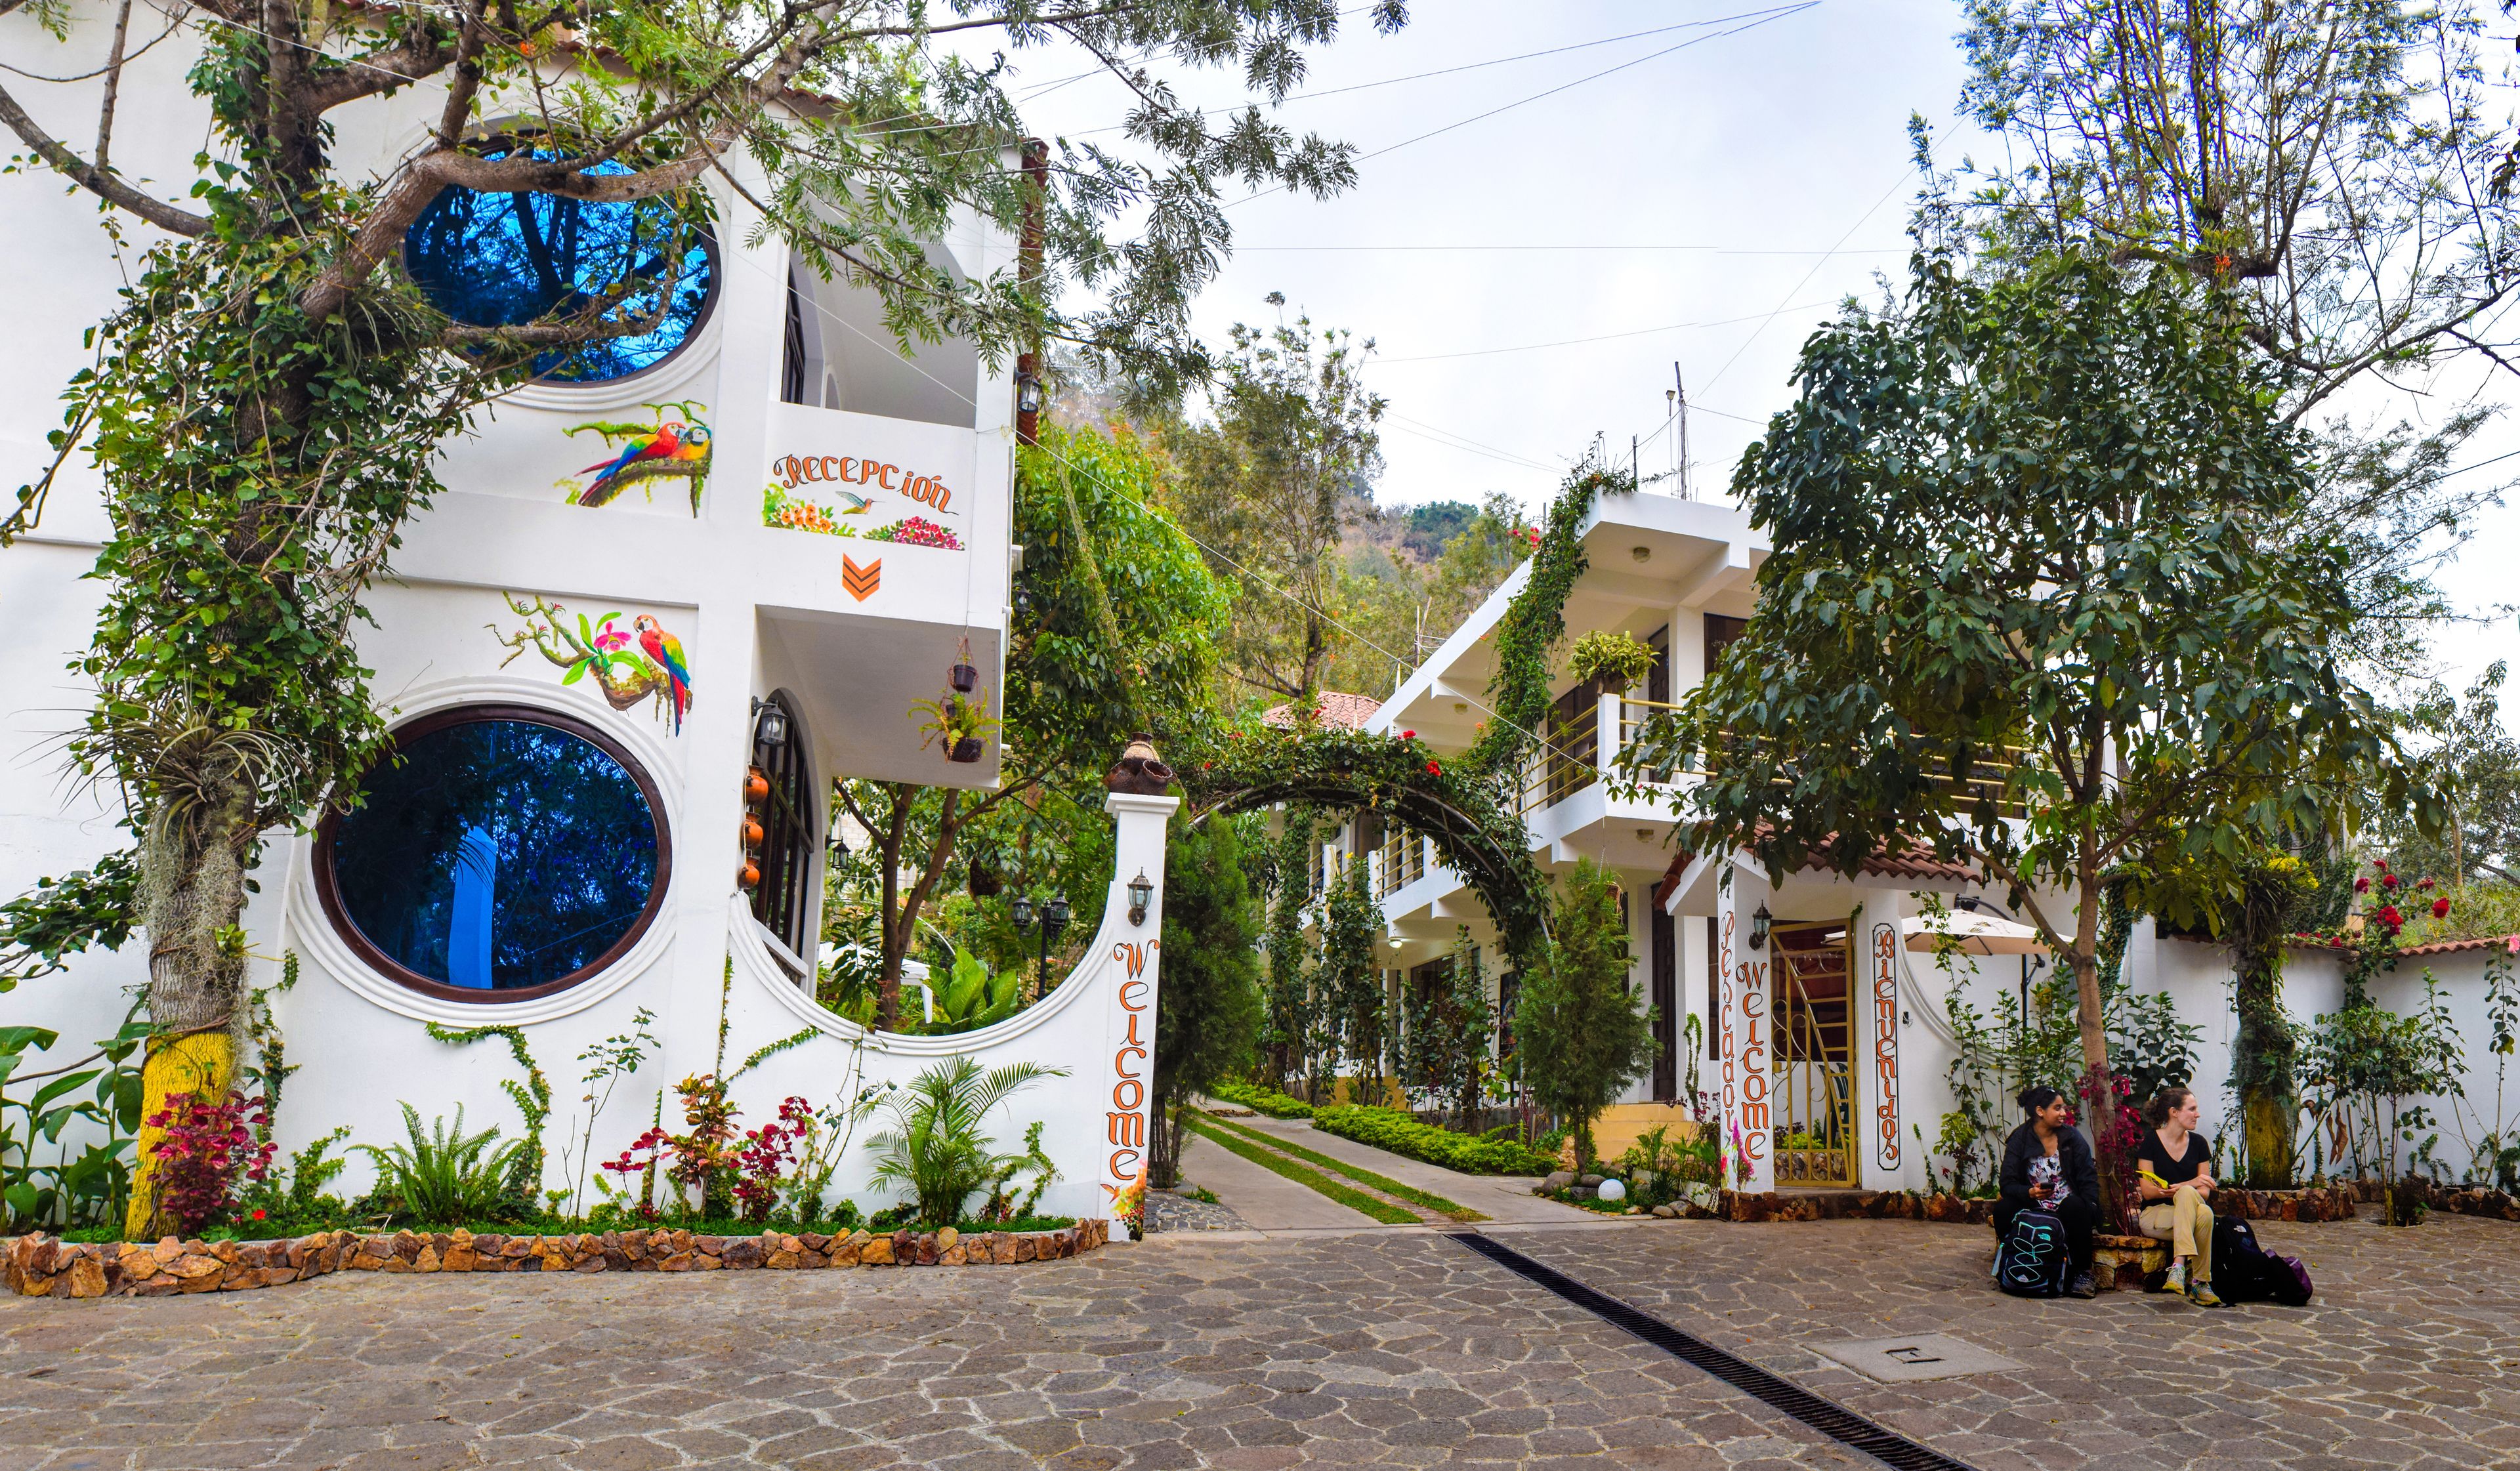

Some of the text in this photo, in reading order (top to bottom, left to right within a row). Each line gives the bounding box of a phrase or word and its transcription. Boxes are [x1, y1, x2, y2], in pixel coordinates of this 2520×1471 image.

[1106, 939, 1160, 1181] Welcome
[1736, 961, 1771, 1161] Welcome
[1875, 929, 1898, 1160] Bienvenidos
